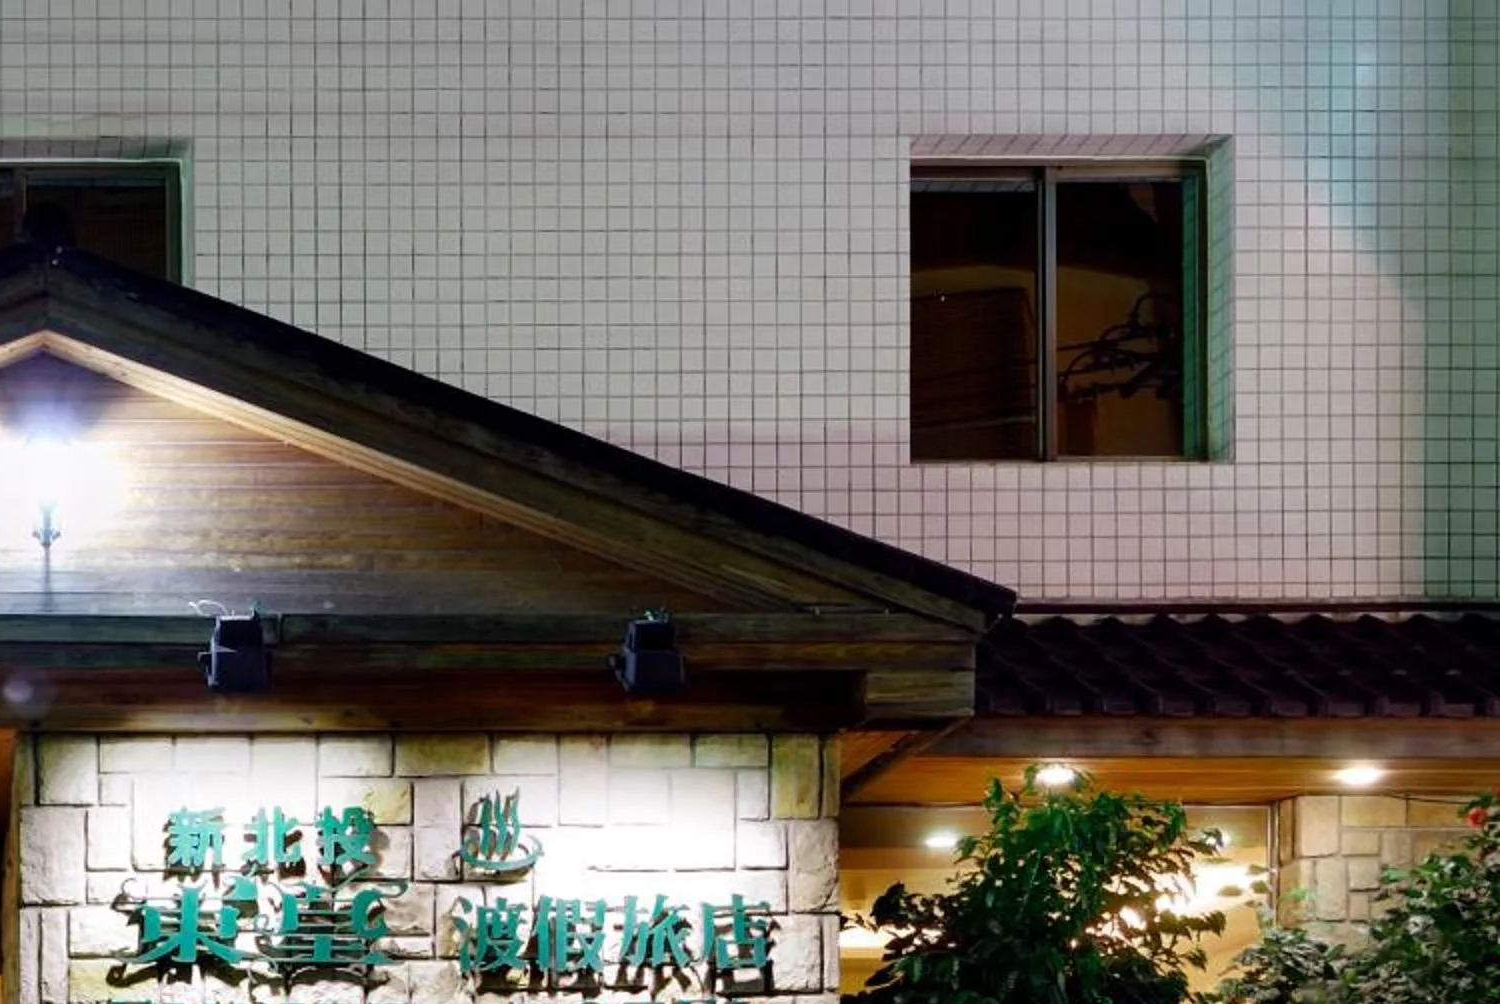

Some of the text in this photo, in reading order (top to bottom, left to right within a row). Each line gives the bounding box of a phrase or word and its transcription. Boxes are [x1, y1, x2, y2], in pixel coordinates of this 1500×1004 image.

[167, 805, 378, 866] 新北投
[451, 894, 772, 974] 渡假旅店
